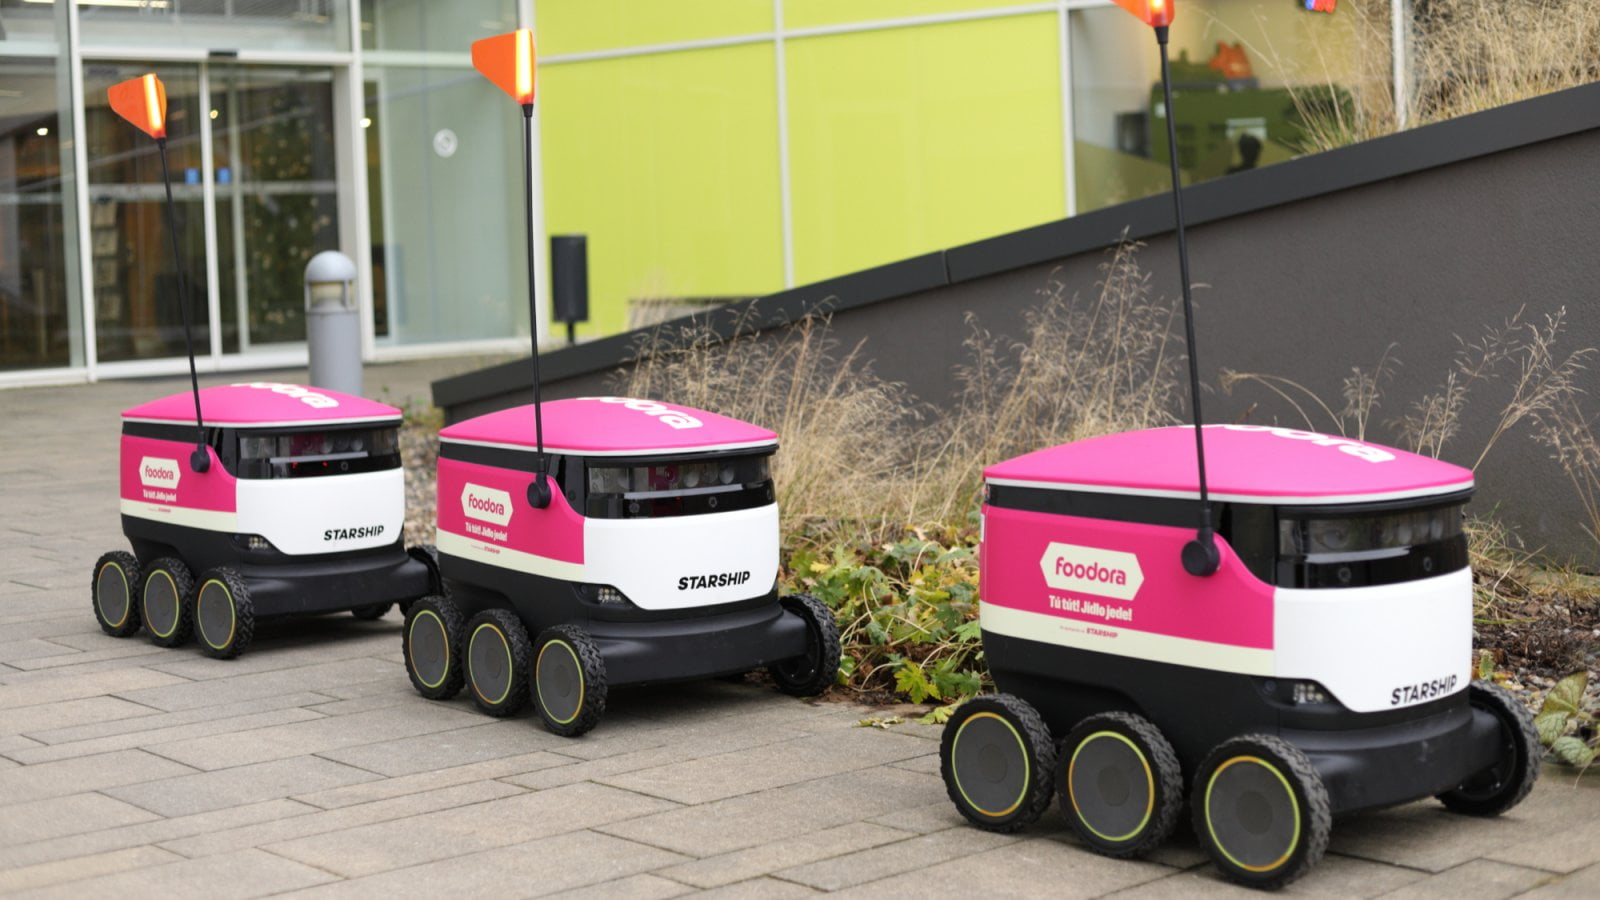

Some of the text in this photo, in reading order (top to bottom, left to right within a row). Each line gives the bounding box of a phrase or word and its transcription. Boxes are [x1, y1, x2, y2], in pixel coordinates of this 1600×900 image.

[145, 465, 174, 481] foodora
[468, 493, 505, 516] foodora
[323, 525, 384, 541] STARSHIP
[677, 571, 751, 590] STARSHIP
[1055, 556, 1126, 586] foodora
[1391, 674, 1457, 705] STARSHIP
